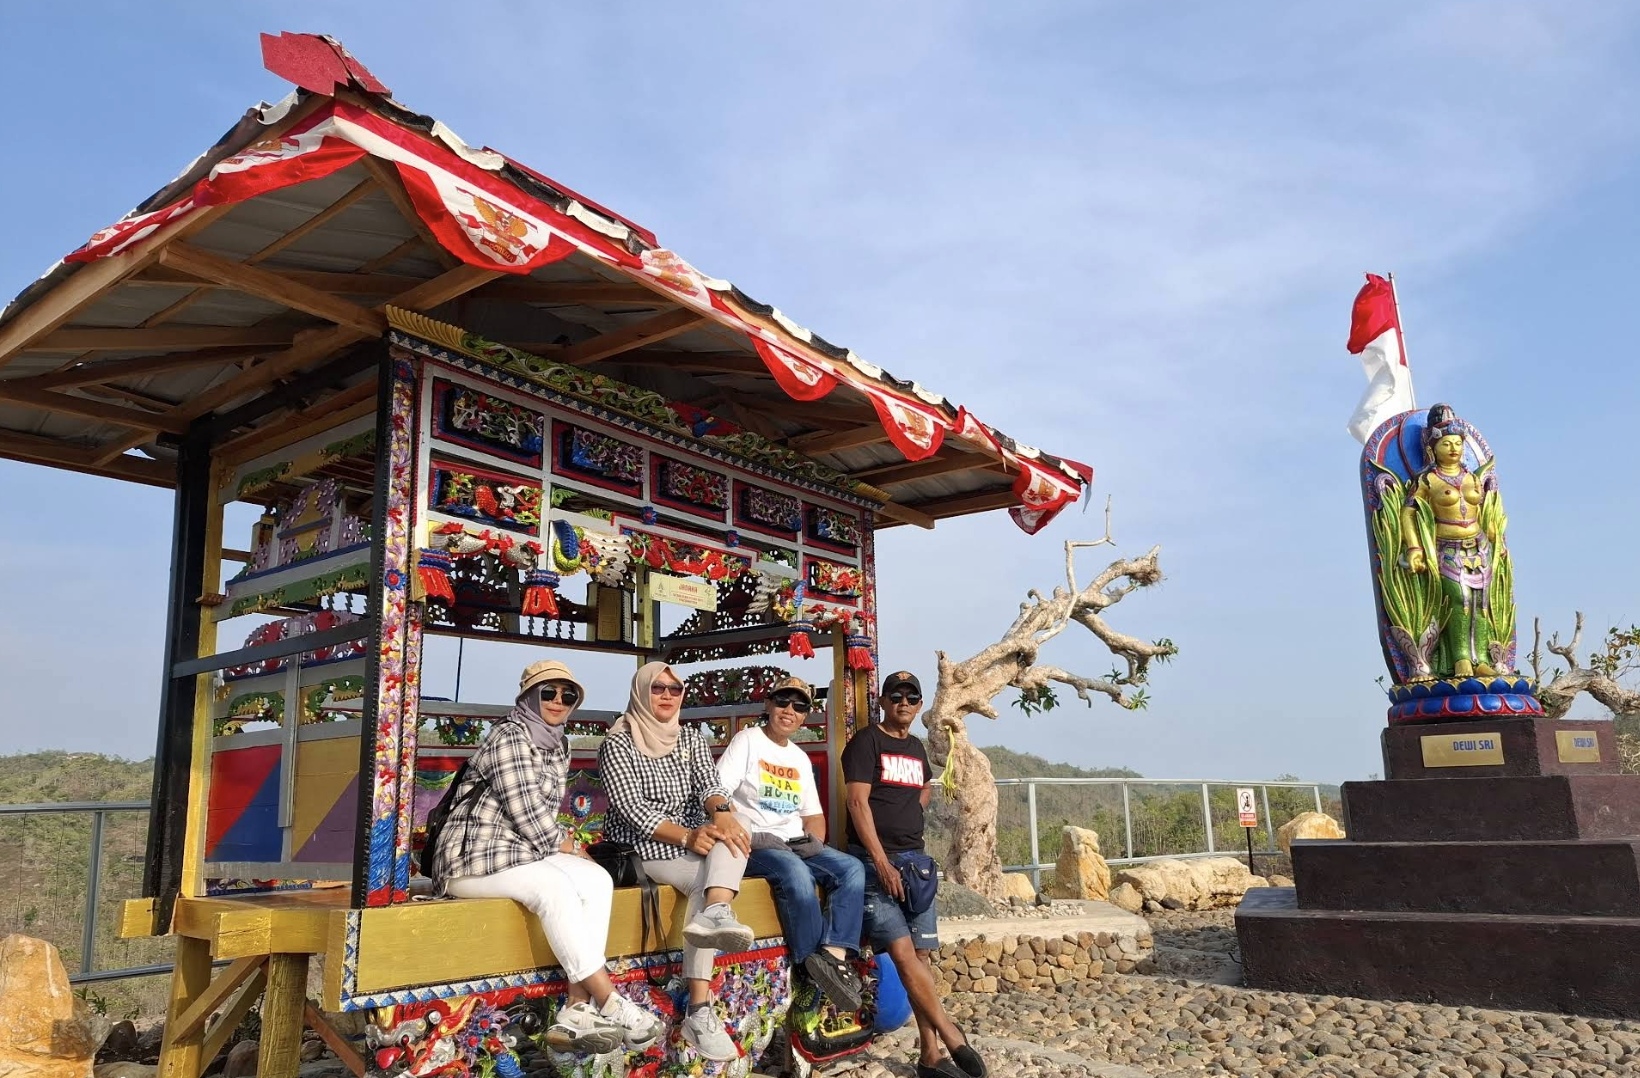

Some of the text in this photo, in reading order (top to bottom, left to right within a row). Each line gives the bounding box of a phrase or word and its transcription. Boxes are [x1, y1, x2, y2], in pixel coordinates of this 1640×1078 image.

[1453, 739, 1494, 751] DEWI SRI
[881, 755, 924, 787] MARVE
[764, 785, 799, 806] HOIC
